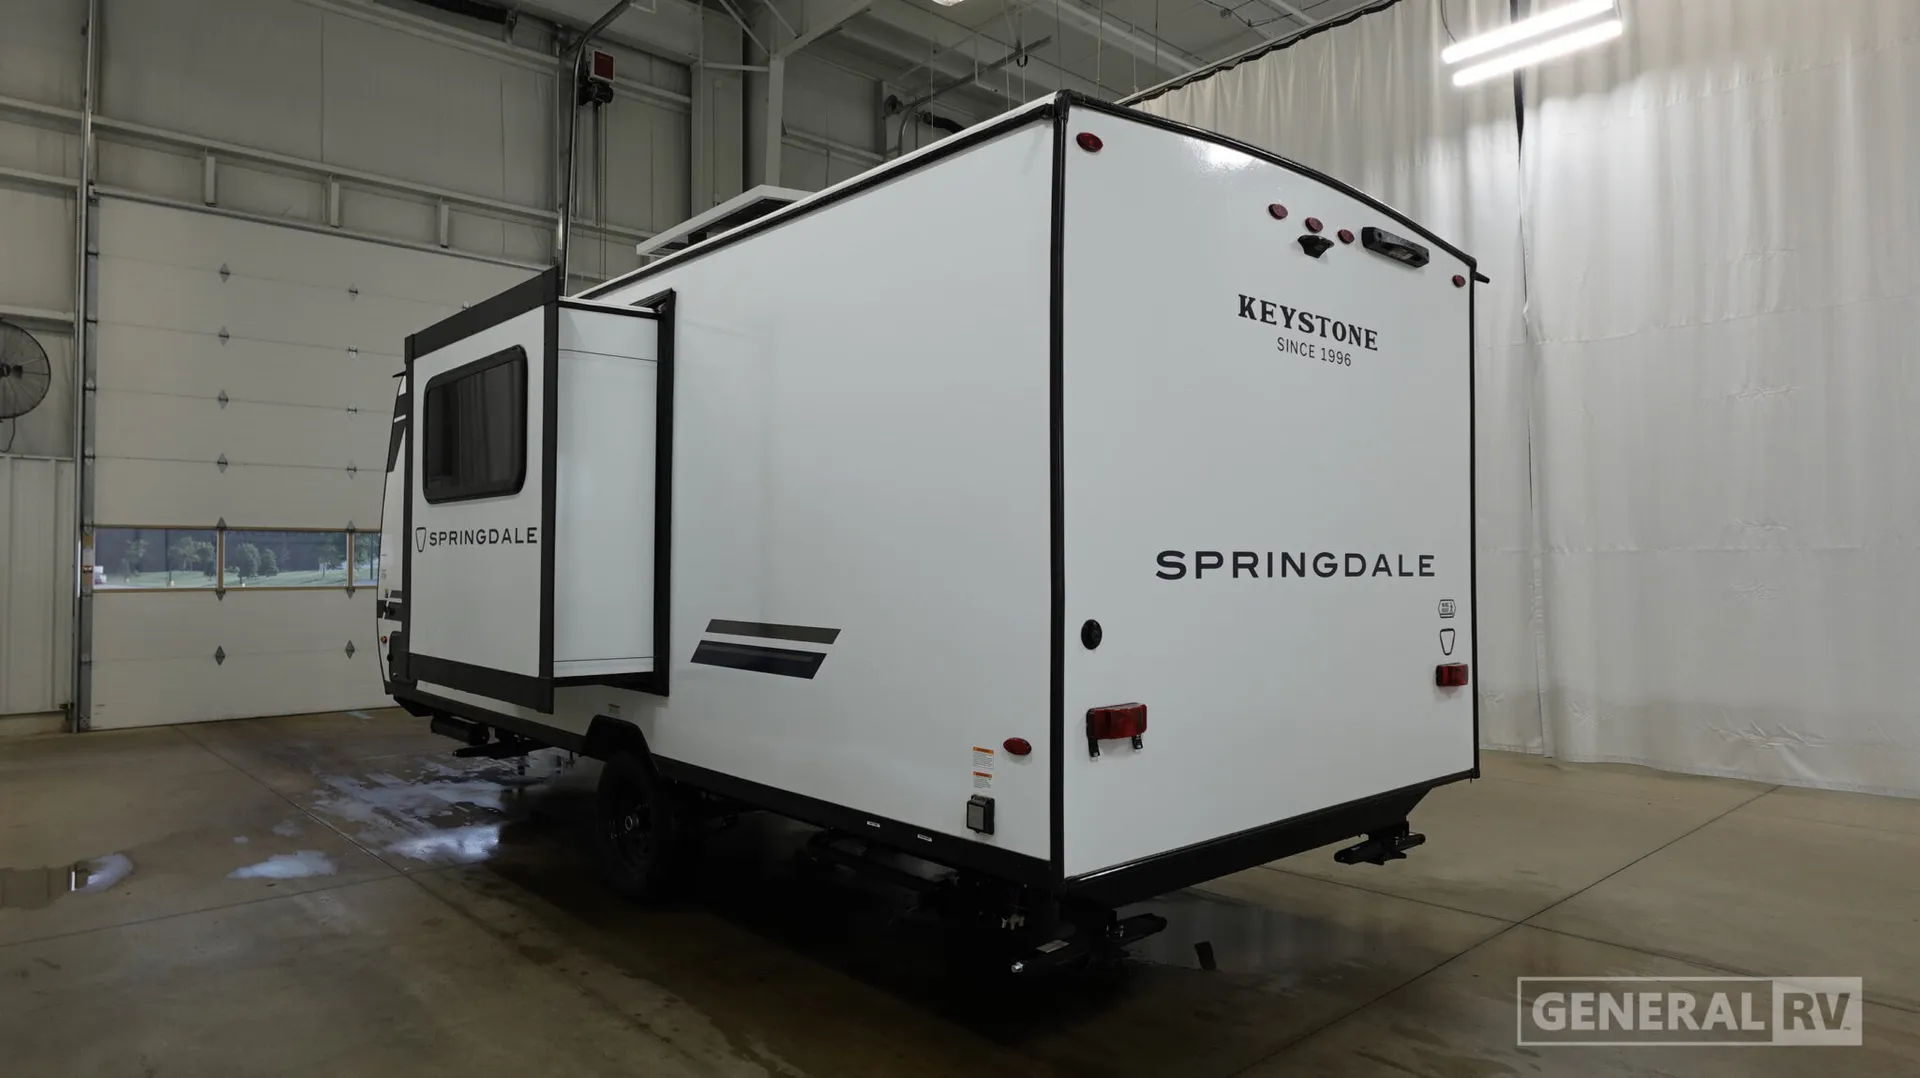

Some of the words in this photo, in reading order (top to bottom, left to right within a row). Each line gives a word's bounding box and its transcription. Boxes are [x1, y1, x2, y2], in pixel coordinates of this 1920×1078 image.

[1238, 293, 1379, 352] KEYSTONE
[1276, 336, 1316, 359] SINCE
[1320, 347, 1352, 367] 1996
[428, 526, 539, 547] SPRINGDALE
[1155, 549, 1436, 581] SPRINGDALE
